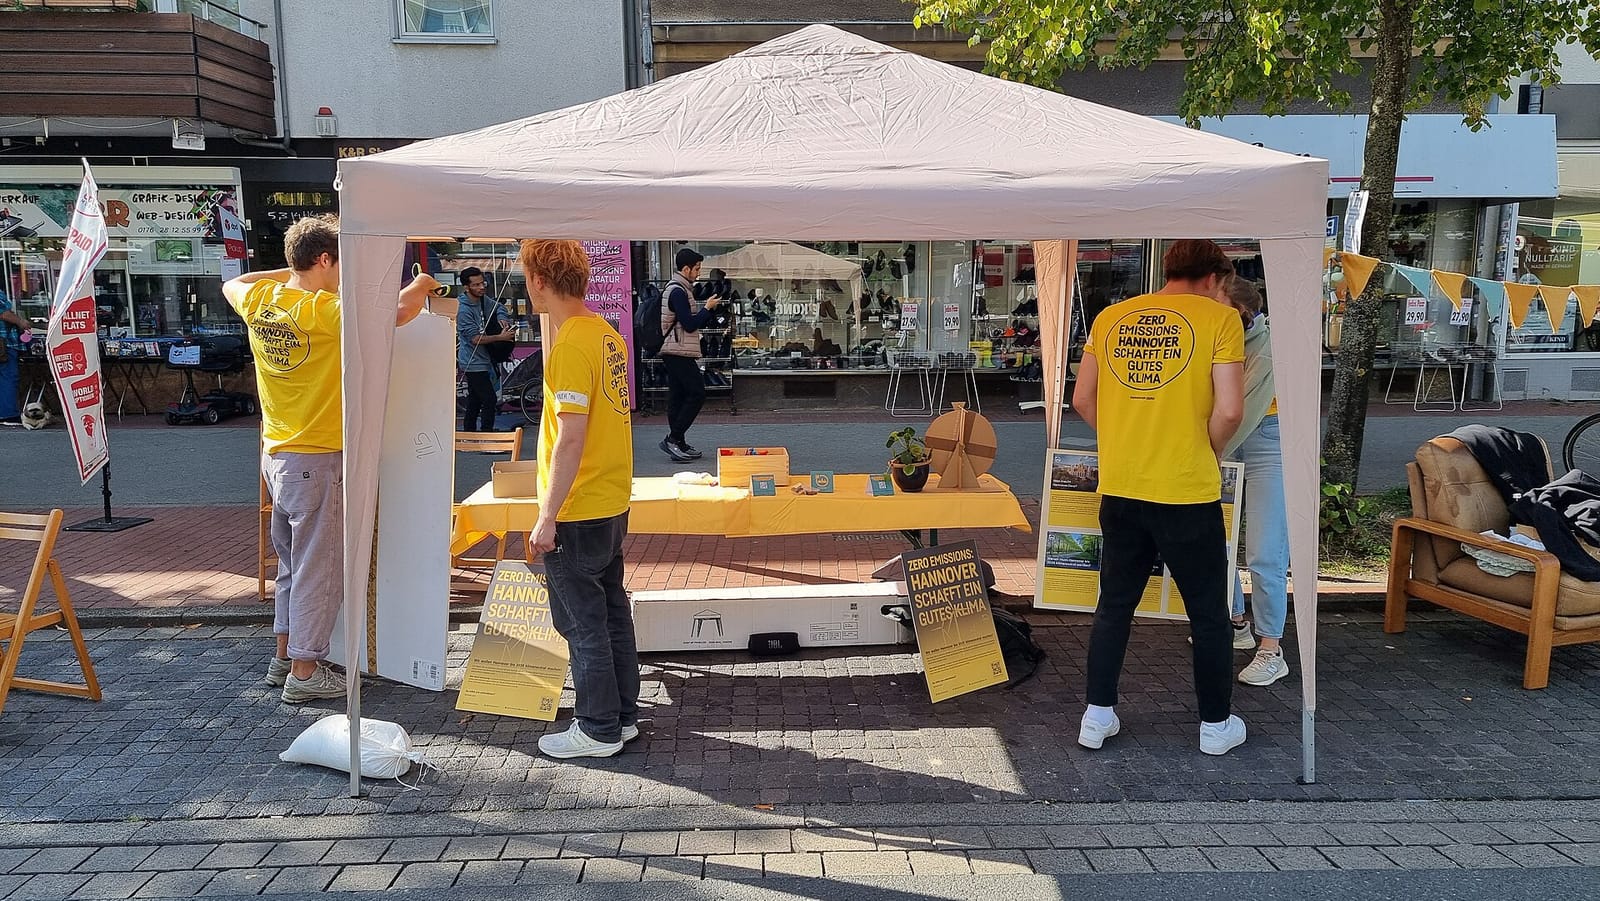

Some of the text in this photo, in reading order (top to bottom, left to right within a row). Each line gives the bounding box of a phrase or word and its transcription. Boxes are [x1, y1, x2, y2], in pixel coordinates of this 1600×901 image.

[0, 194, 40, 204] ERKAUF
[69, 228, 93, 252] PAID
[1551, 244, 1576, 254] KIND
[1525, 253, 1575, 263] NULLTARIF
[584, 293, 623, 302] ARDWARE
[597, 312, 621, 320] WARE
[1137, 315, 1166, 325] ZERO
[1406, 311, 1425, 322] 29,90
[1452, 311, 1470, 322] 27,90
[62, 321, 86, 330] FLATS
[1118, 325, 1182, 336] EMISSIONS:
[1118, 337, 1179, 347] HANNOVER
[1113, 348, 1181, 359] SCHAFFT EIN
[1127, 360, 1163, 371] GUTES
[1128, 373, 1160, 383] KLIMA
[907, 548, 974, 572] ZERO EMISSIONS:
[497, 570, 524, 583] ZERO
[910, 562, 979, 591] HANNOVER
[914, 580, 982, 609] SCHAFFT EIN
[488, 603, 549, 622] SCHAFFT
[918, 598, 987, 627] GUTES KLIMA
[483, 621, 527, 637] GUTES
